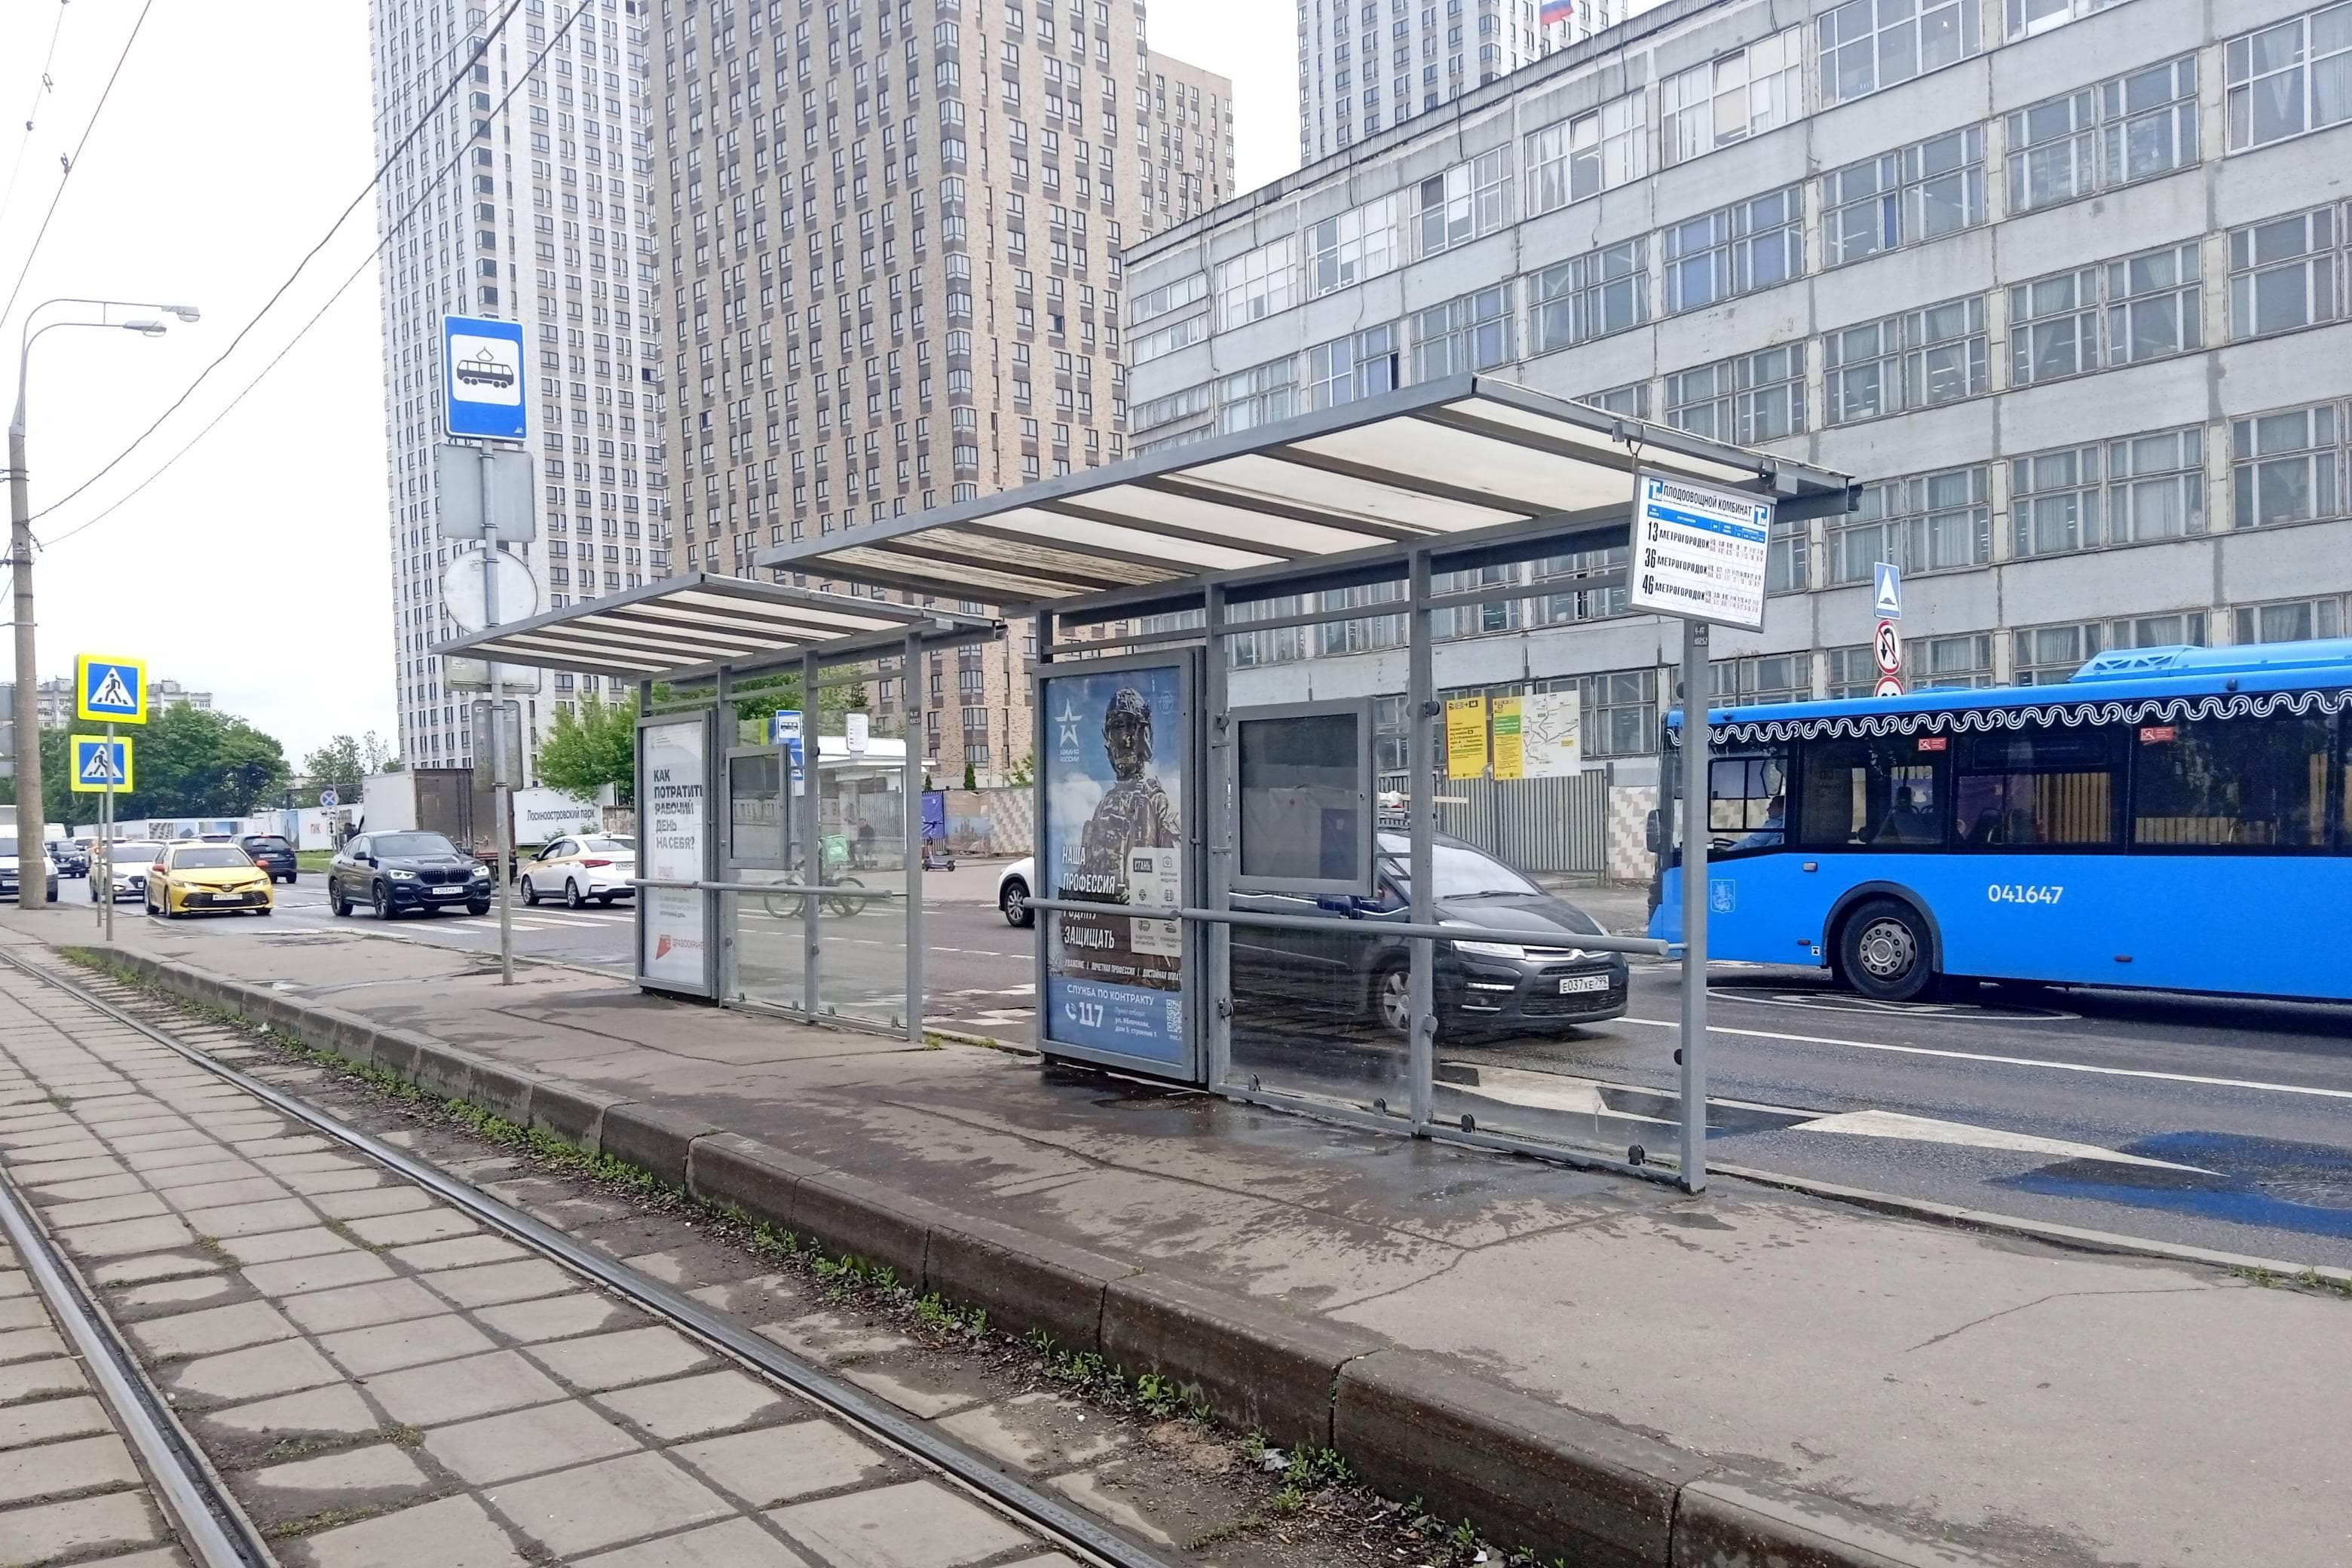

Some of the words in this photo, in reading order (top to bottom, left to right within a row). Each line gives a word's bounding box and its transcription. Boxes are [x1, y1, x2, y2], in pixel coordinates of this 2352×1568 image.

[1664, 485, 1717, 509] ПЛОДООВОЩНОЙ
[1717, 498, 1753, 517] КОМБИНАТ
[1648, 521, 1658, 542] 13
[1659, 529, 1710, 549] МЕТРОГОРОДОК
[1645, 547, 1656, 568] 36
[1657, 556, 1707, 574] МЕТРОГОРОДОК
[1642, 574, 1654, 595] 46
[1655, 582, 1705, 601] МЕТРОГОРОДОК
[654, 769, 670, 782] КАК
[528, 807, 580, 822] Лосиноостровский
[580, 809, 596, 820] парк
[654, 799, 694, 815] РАБОЧИЙ
[656, 819, 677, 834] ДЕНЬ
[657, 837, 668, 849] НА
[669, 836, 695, 850] СЕБЯ?
[1062, 846, 1086, 865] НАША
[1063, 873, 1116, 894] ПРОФЕССИЯ
[1988, 884, 2063, 904] 041647
[1064, 926, 1115, 949] ЗАЩИЩАТЬ
[1111, 965, 1135, 975] ПРОФЕССИЯ
[1143, 969, 1167, 980] ДОСТОЙНАЯ
[1067, 985, 1096, 997] СЛУЖБА
[1098, 989, 1108, 999] ПО
[1110, 991, 1154, 1006] КОНТРАКТУ
[1079, 1001, 1104, 1027] 117
